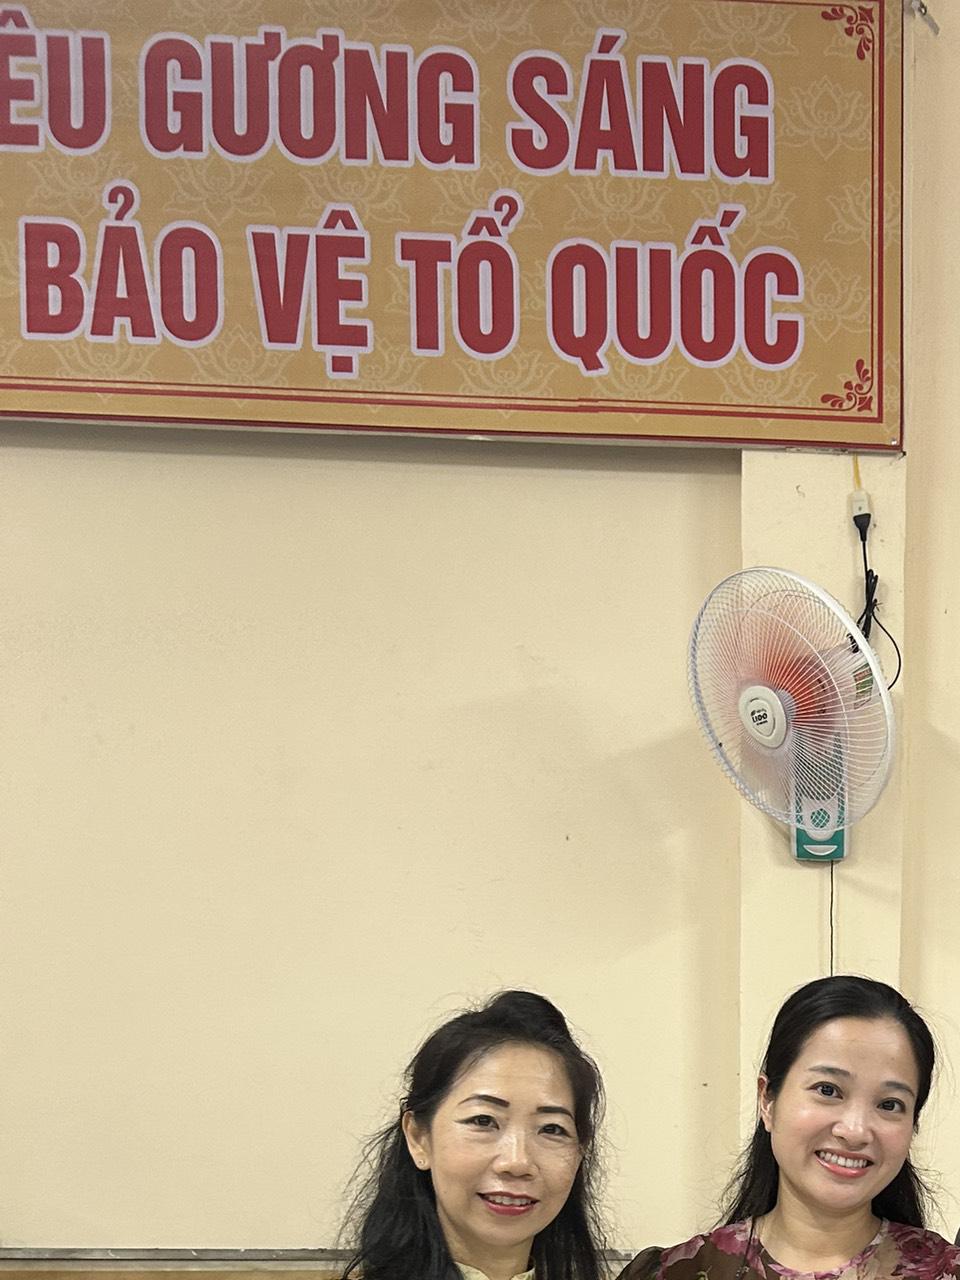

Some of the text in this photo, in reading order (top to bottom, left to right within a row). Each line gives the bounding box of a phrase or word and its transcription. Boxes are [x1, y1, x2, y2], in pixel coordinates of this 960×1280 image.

[0, 8, 771, 179] ÊU GƯƠNG SÁNG
[25, 186, 801, 374] BẢO VỆ TỔ QUỐC
